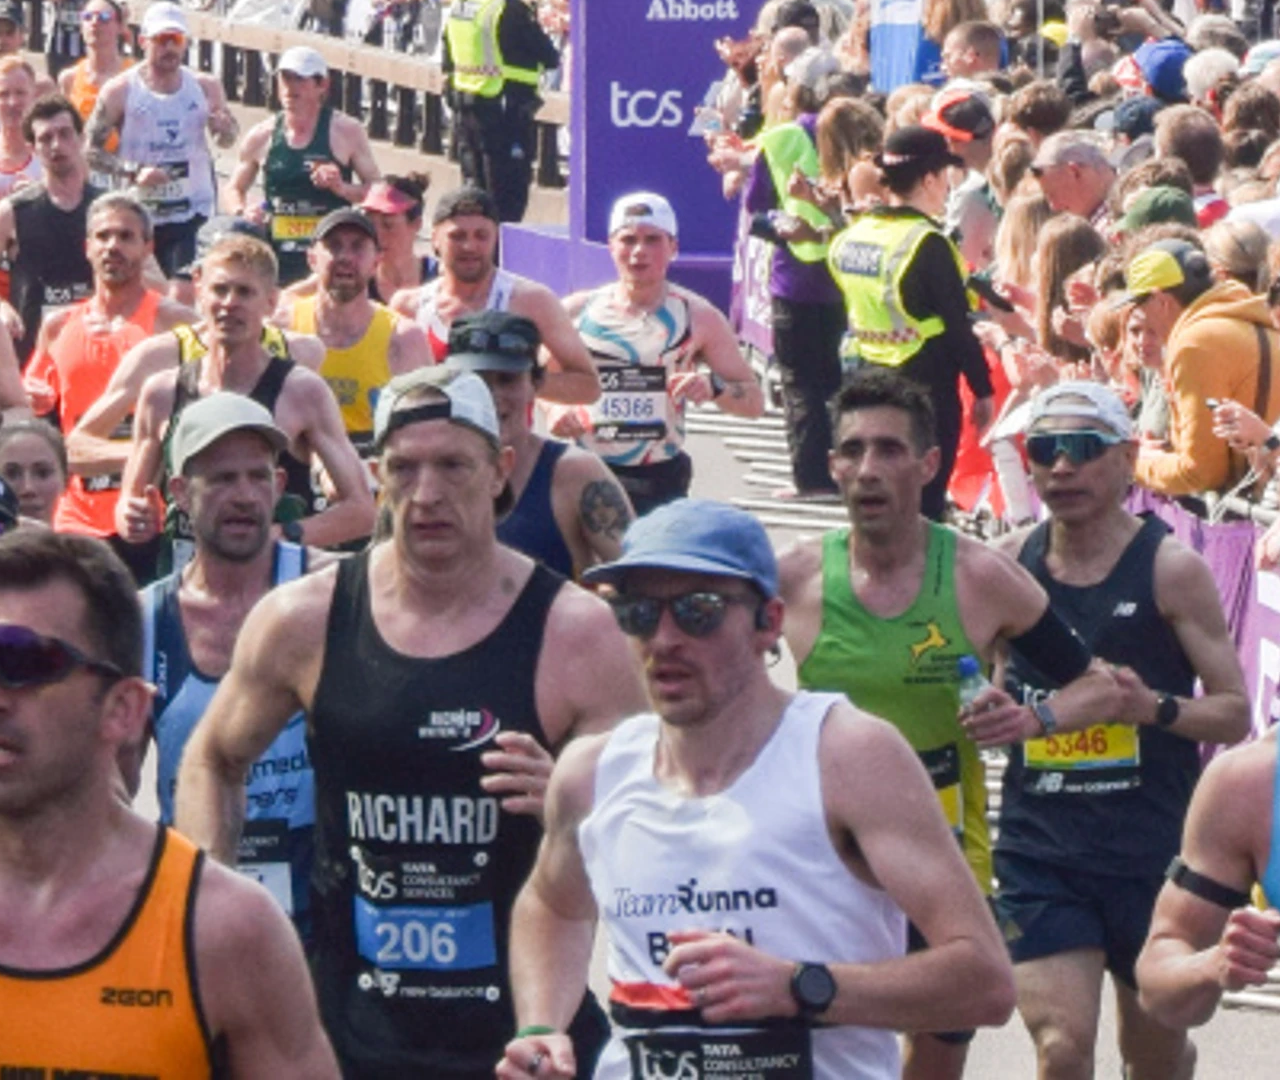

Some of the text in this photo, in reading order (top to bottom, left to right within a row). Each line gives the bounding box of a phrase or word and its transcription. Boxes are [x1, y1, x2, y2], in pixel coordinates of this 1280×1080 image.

[609, 80, 683, 128] tcs
[347, 790, 500, 845] RICHARD
[375, 919, 457, 964] 206
[700, 1043, 743, 1056] TATA
